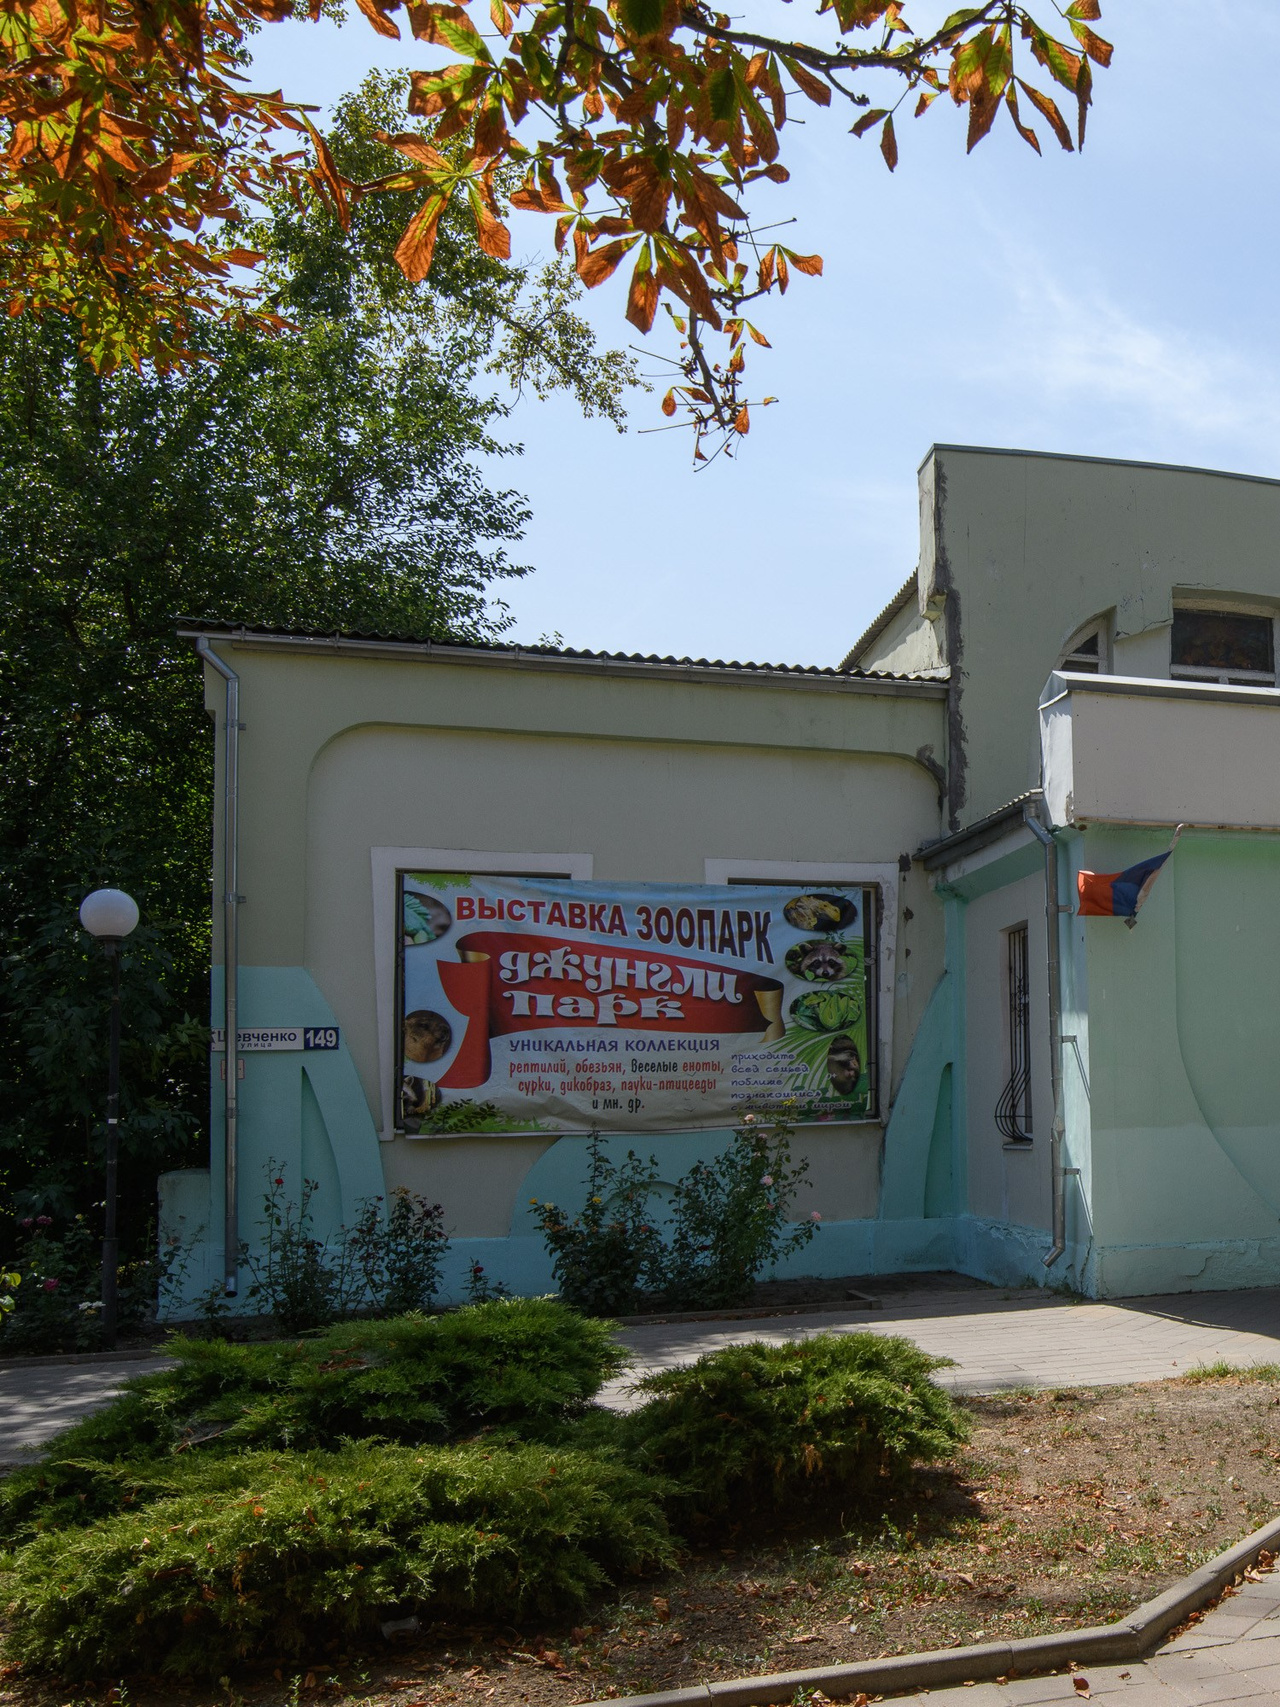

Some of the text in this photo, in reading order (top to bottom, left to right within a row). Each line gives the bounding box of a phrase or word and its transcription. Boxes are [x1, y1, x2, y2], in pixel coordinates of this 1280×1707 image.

[456, 896, 775, 965] ВЫСТАВКА ЗООПАРК
[240, 1042, 272, 1050] улица
[306, 1029, 337, 1048] 149
[509, 1038, 720, 1054] УНИКАЛЬНАЯ КОЛЛЕКЦИЯ
[731, 1051, 796, 1065] приходите
[509, 1058, 570, 1078] рептилий,
[575, 1057, 626, 1076] обезьян,
[682, 1060, 724, 1075] еноты,
[731, 1064, 760, 1074] всей
[518, 1076, 717, 1096] сурки, дикобраз, пауки-птицееды
[730, 1077, 784, 1087] поближе
[592, 1097, 645, 1113] и мн. др.
[730, 1103, 738, 1111] с
